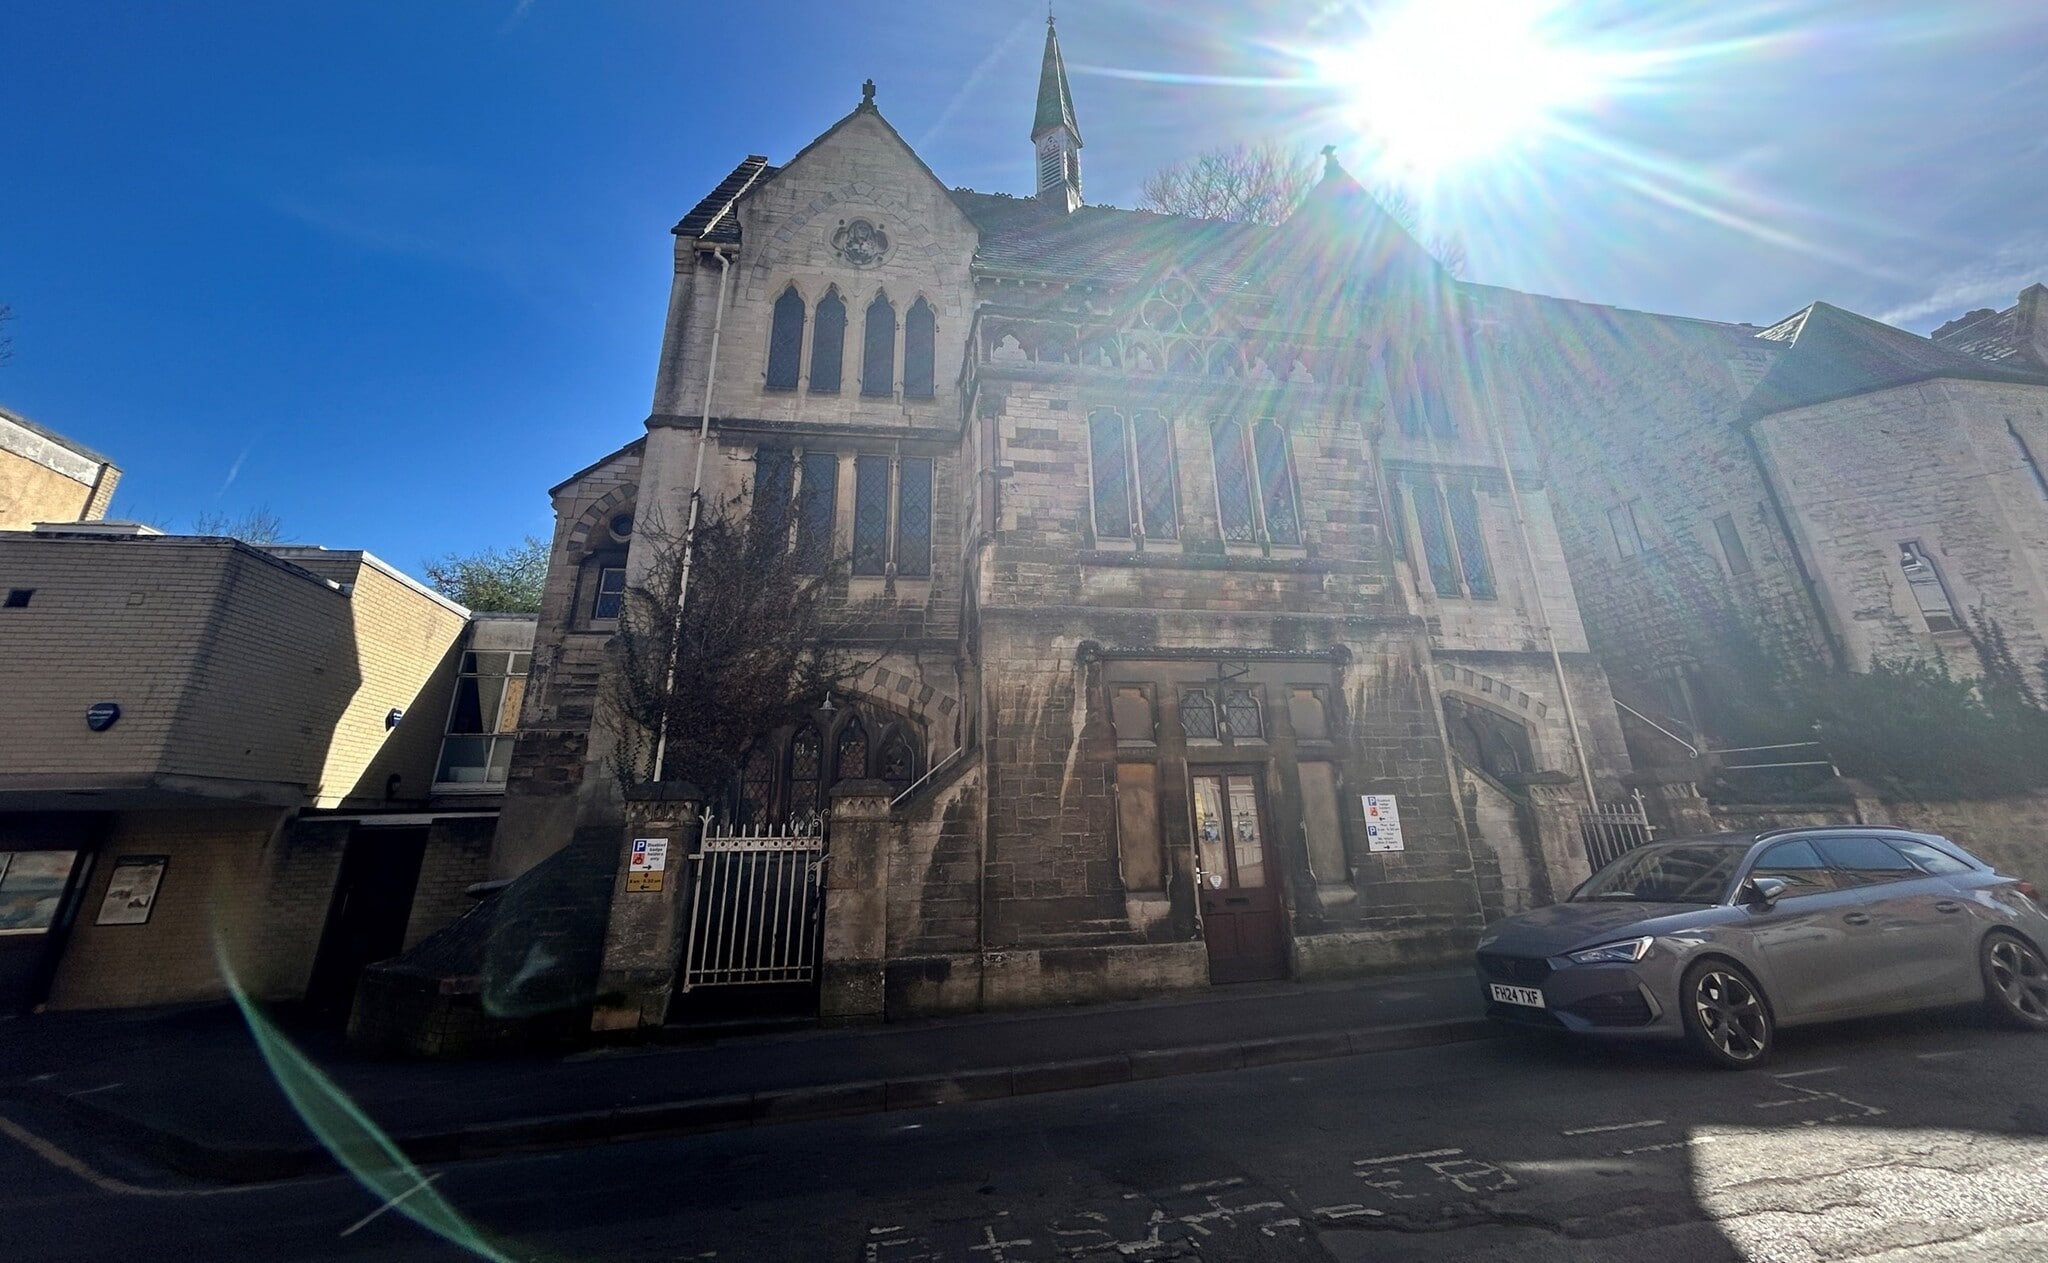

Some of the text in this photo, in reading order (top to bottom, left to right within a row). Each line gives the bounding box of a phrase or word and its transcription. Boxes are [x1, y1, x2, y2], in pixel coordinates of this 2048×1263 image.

[636, 841, 645, 851] P
[1494, 986, 1538, 1005] FH24 TXF
